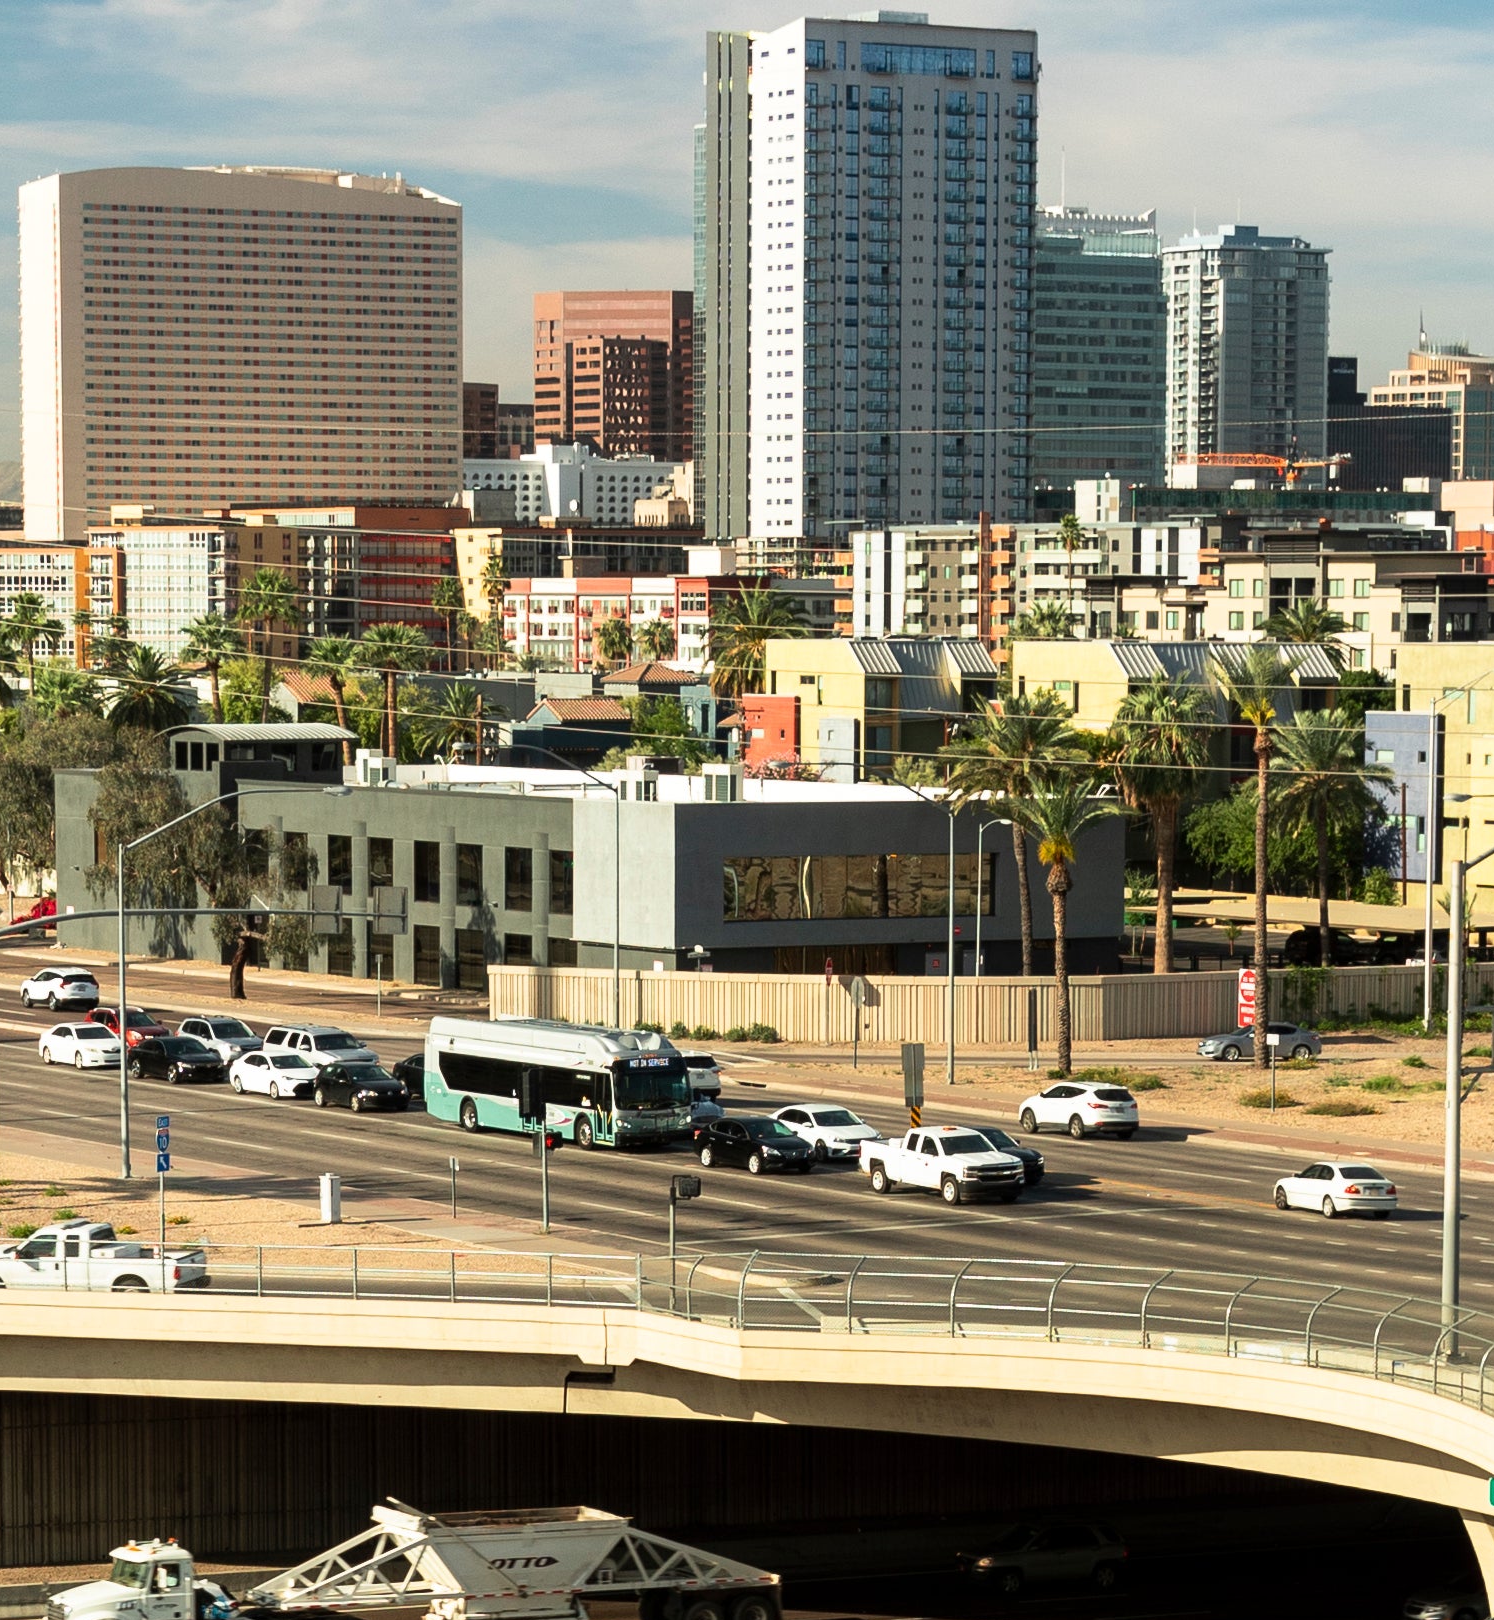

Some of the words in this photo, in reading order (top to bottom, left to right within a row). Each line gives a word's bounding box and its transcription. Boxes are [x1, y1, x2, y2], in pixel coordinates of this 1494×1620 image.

[630, 1059, 639, 1068] NOT
[640, 1059, 647, 1067] IN
[648, 1057, 669, 1067] SERVICE
[159, 1136, 168, 1150] 10
[488, 1556, 559, 1570] OTTO
